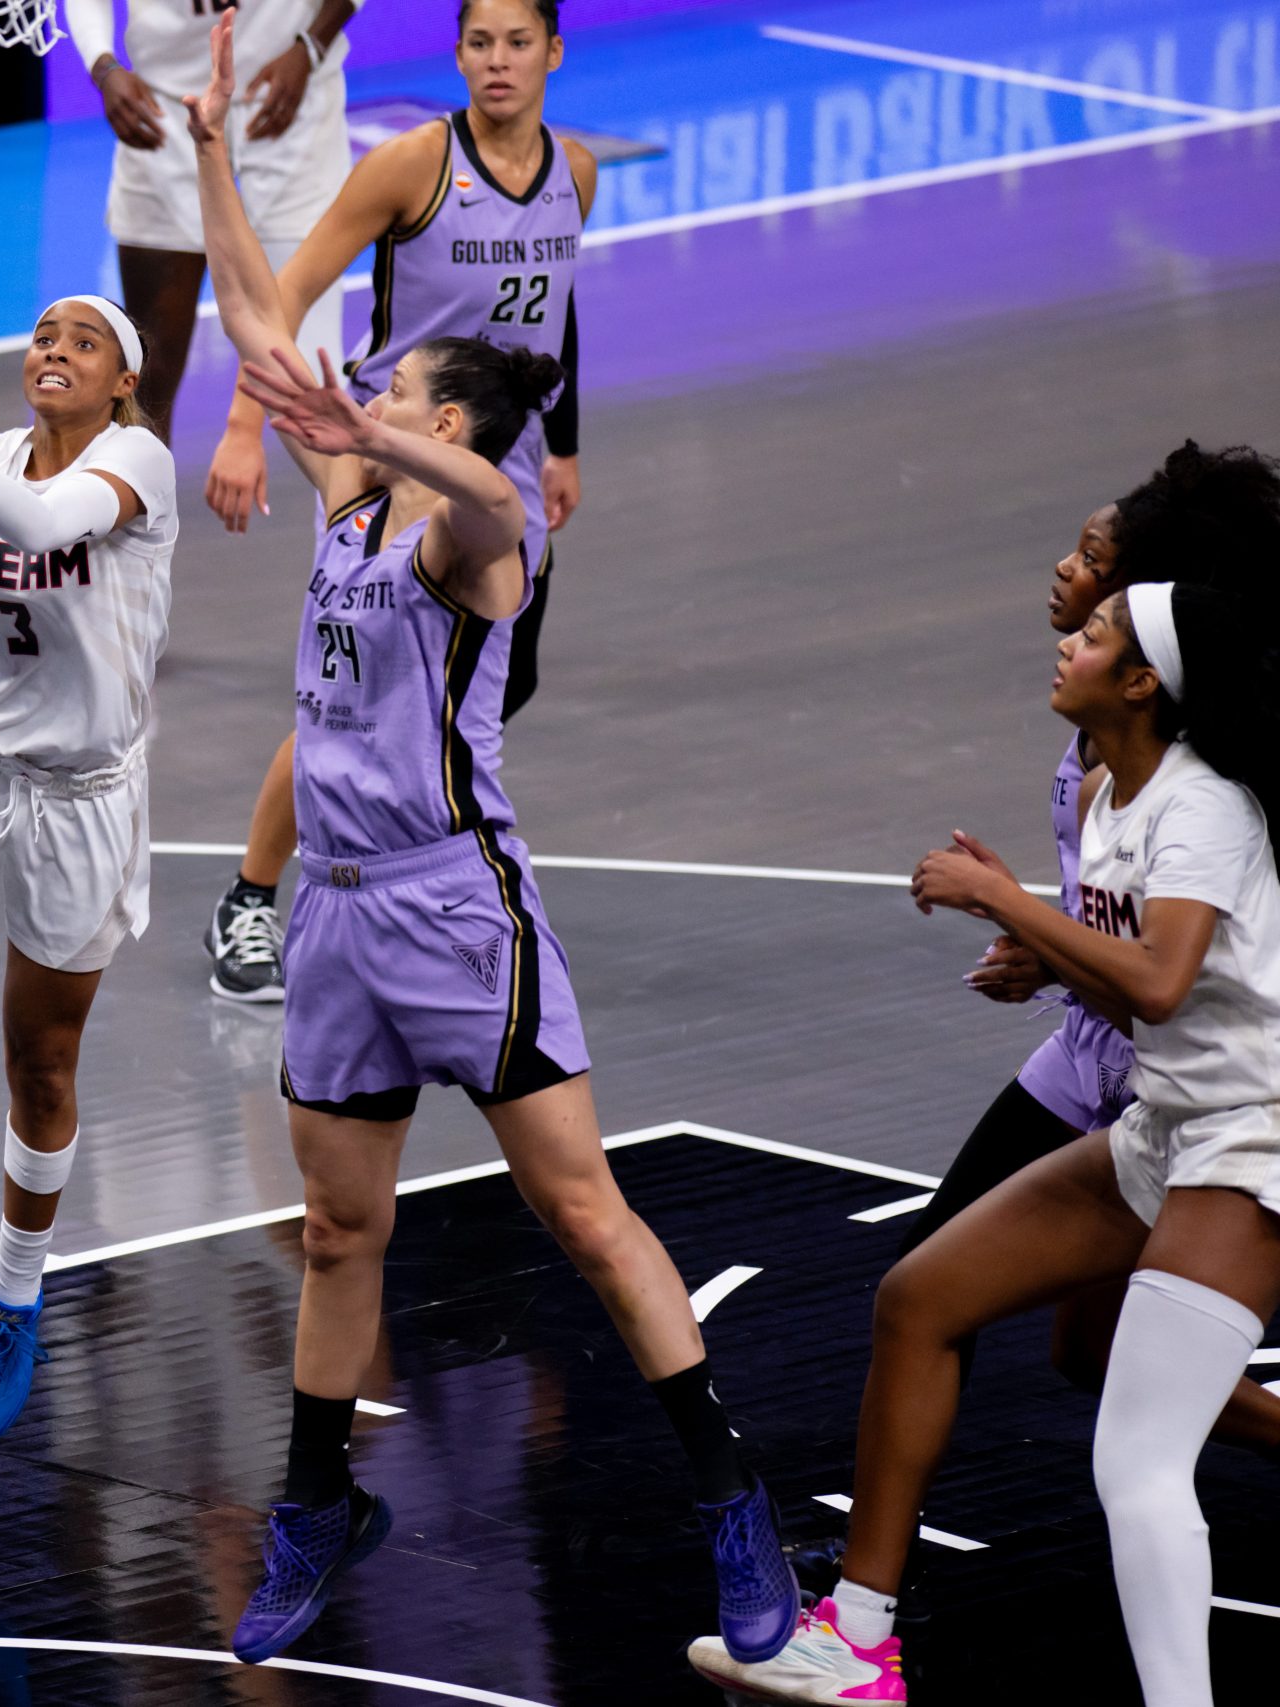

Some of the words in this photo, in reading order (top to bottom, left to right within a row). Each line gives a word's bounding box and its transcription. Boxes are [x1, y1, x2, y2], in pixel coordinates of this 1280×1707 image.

[452, 240, 526, 264] GOLDEN
[534, 235, 577, 262] STATE
[488, 273, 550, 325] 22
[316, 621, 363, 686] 24
[331, 863, 361, 887] GSV
[1081, 883, 1142, 939] EAM
